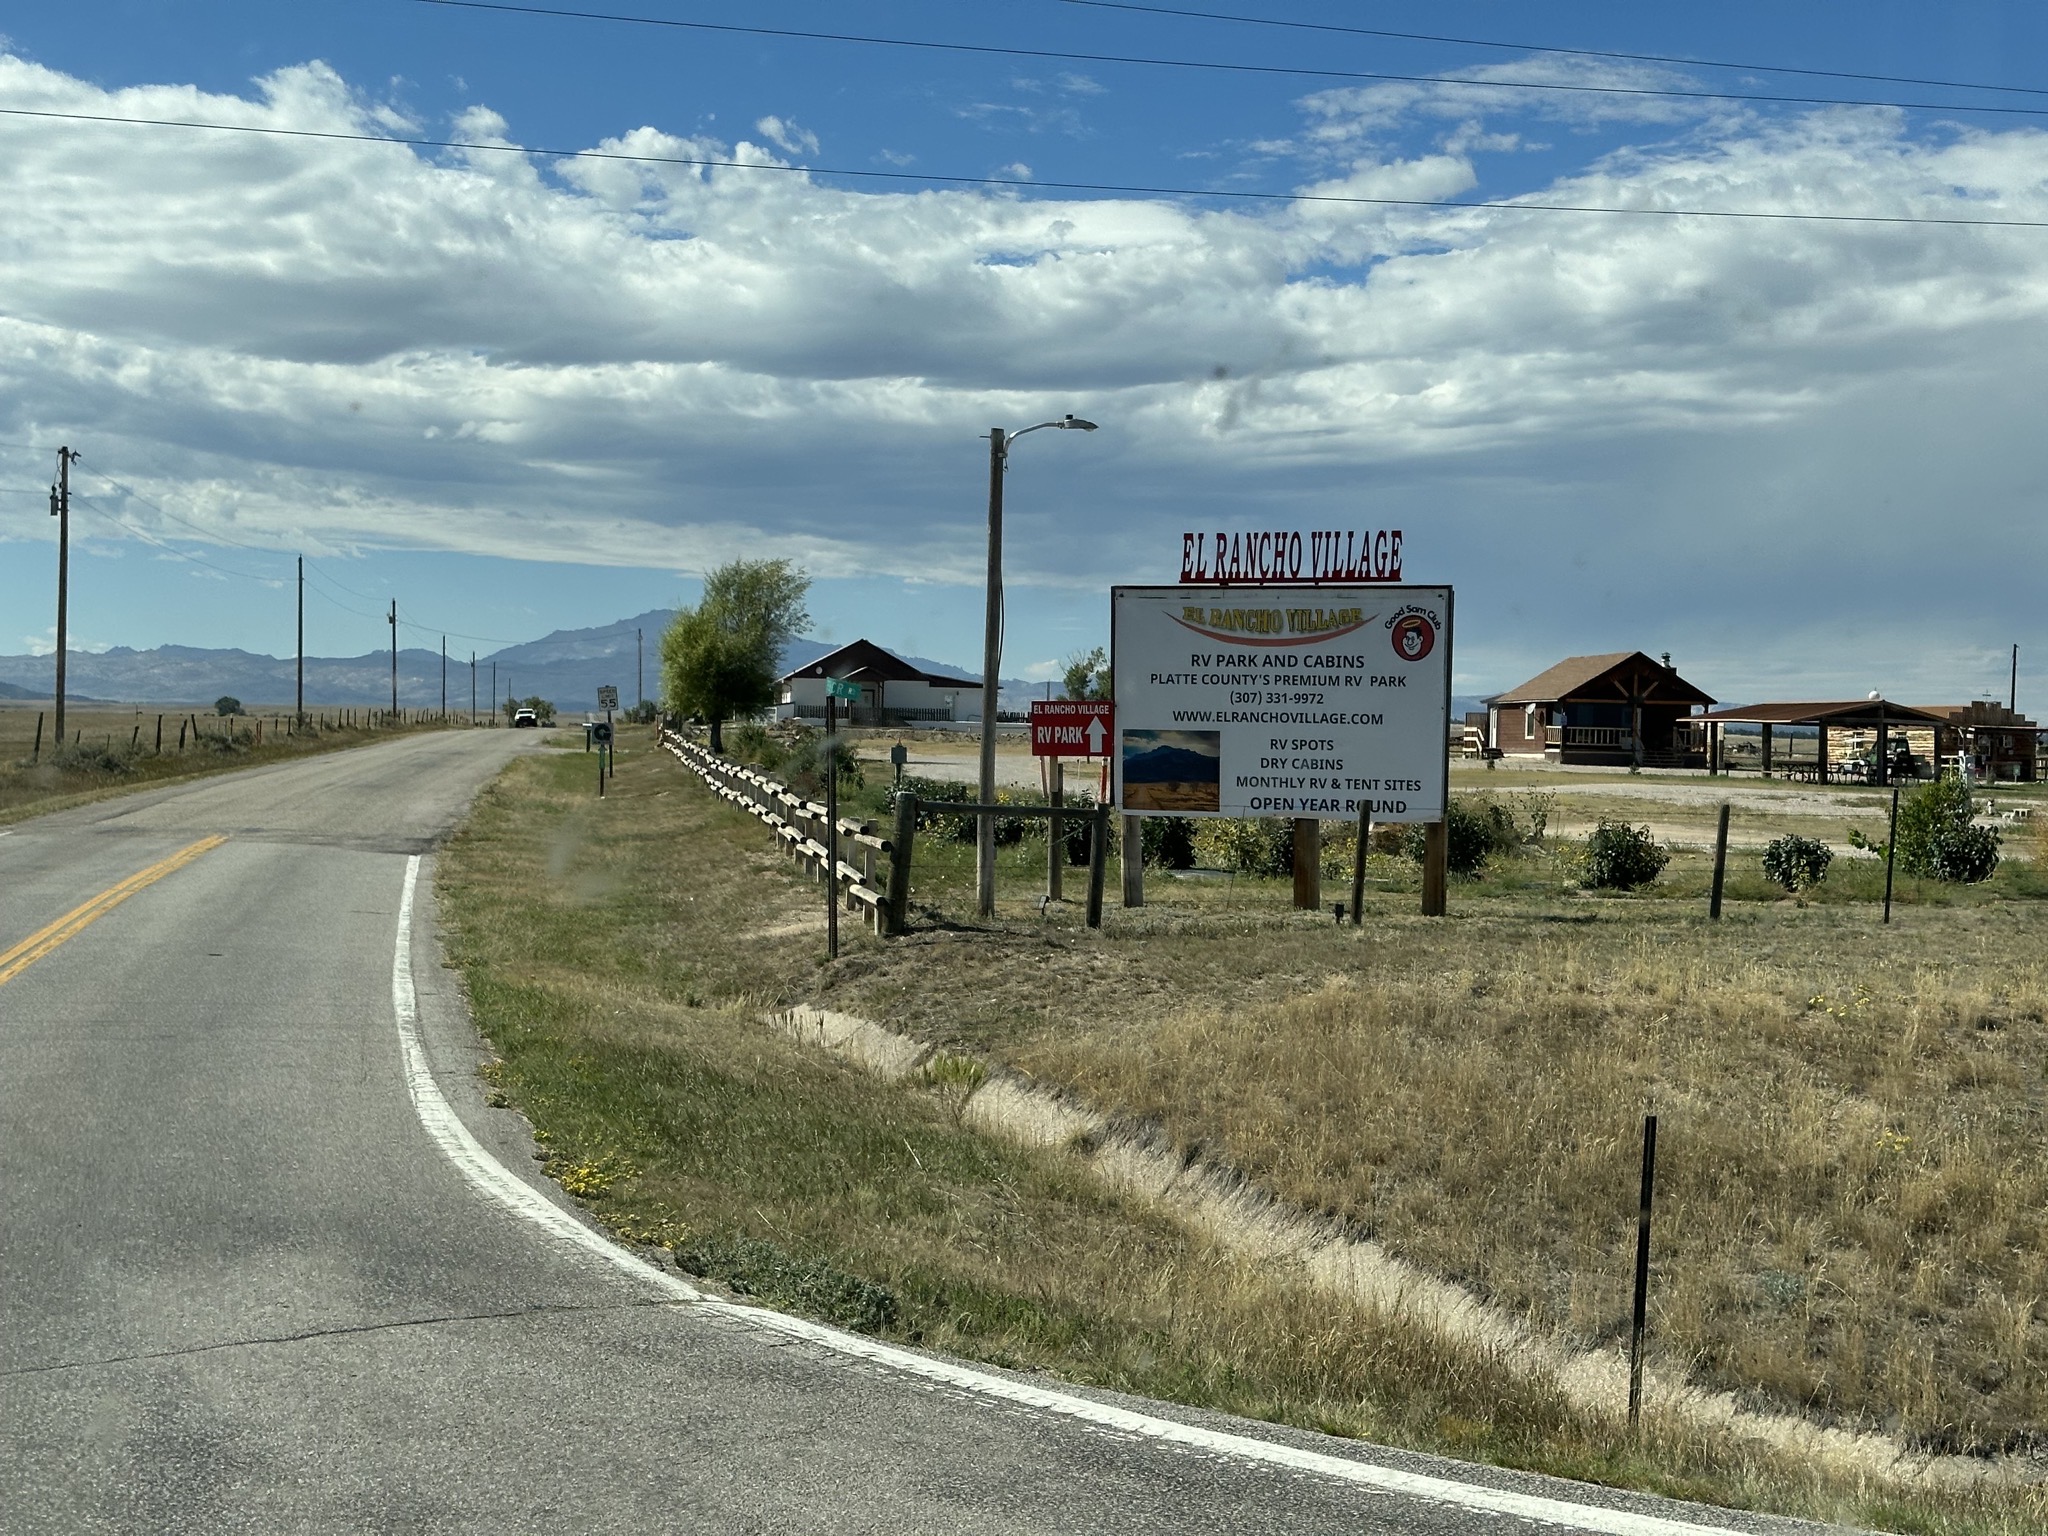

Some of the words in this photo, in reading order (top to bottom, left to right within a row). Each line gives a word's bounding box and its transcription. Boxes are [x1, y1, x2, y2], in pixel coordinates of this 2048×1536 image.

[1182, 532, 1208, 580] EL
[1213, 531, 1301, 579] RANCHO
[1311, 530, 1403, 579] VILLAGE
[1182, 606, 1205, 624] EL
[1208, 608, 1283, 633] RANCHO
[1286, 608, 1362, 632] VILLAGE
[1385, 607, 1405, 629] Good
[1406, 604, 1426, 615] Sam
[1427, 610, 1441, 630] Club
[1191, 654, 1211, 668] RV
[1216, 654, 1258, 668] PARK
[1262, 654, 1299, 668] AND
[1303, 655, 1365, 669] CABINS
[1150, 673, 1197, 685] PLATTE
[1201, 673, 1270, 686] COUNTY'S
[1274, 674, 1340, 687] PREMIUM
[1345, 675, 1362, 687] RV
[1370, 676, 1406, 687] PARK
[600, 699, 617, 708] 55
[1230, 691, 1262, 705] (307)
[1266, 692, 1324, 705] 331-9972
[1033, 704, 1043, 714] EL
[1044, 704, 1076, 714] RANCHO
[1077, 704, 1109, 714] VILLAGE
[1173, 711, 1383, 725] WWW.ELRANCHOVILLAGE.COM
[1037, 726, 1052, 743] RV
[1054, 726, 1083, 743] PARK
[1270, 739, 1288, 750] RV
[1292, 739, 1334, 751] SPOTS
[1260, 758, 1288, 769] DRY
[1291, 758, 1343, 770] CABINS
[1236, 776, 1305, 789] MONTHLY
[1309, 777, 1327, 789] RV
[1330, 778, 1341, 790] &
[1345, 778, 1380, 790] TENT
[1384, 779, 1421, 791] SITES
[1250, 797, 1294, 811] OPEN
[1299, 798, 1341, 812] YEAR
